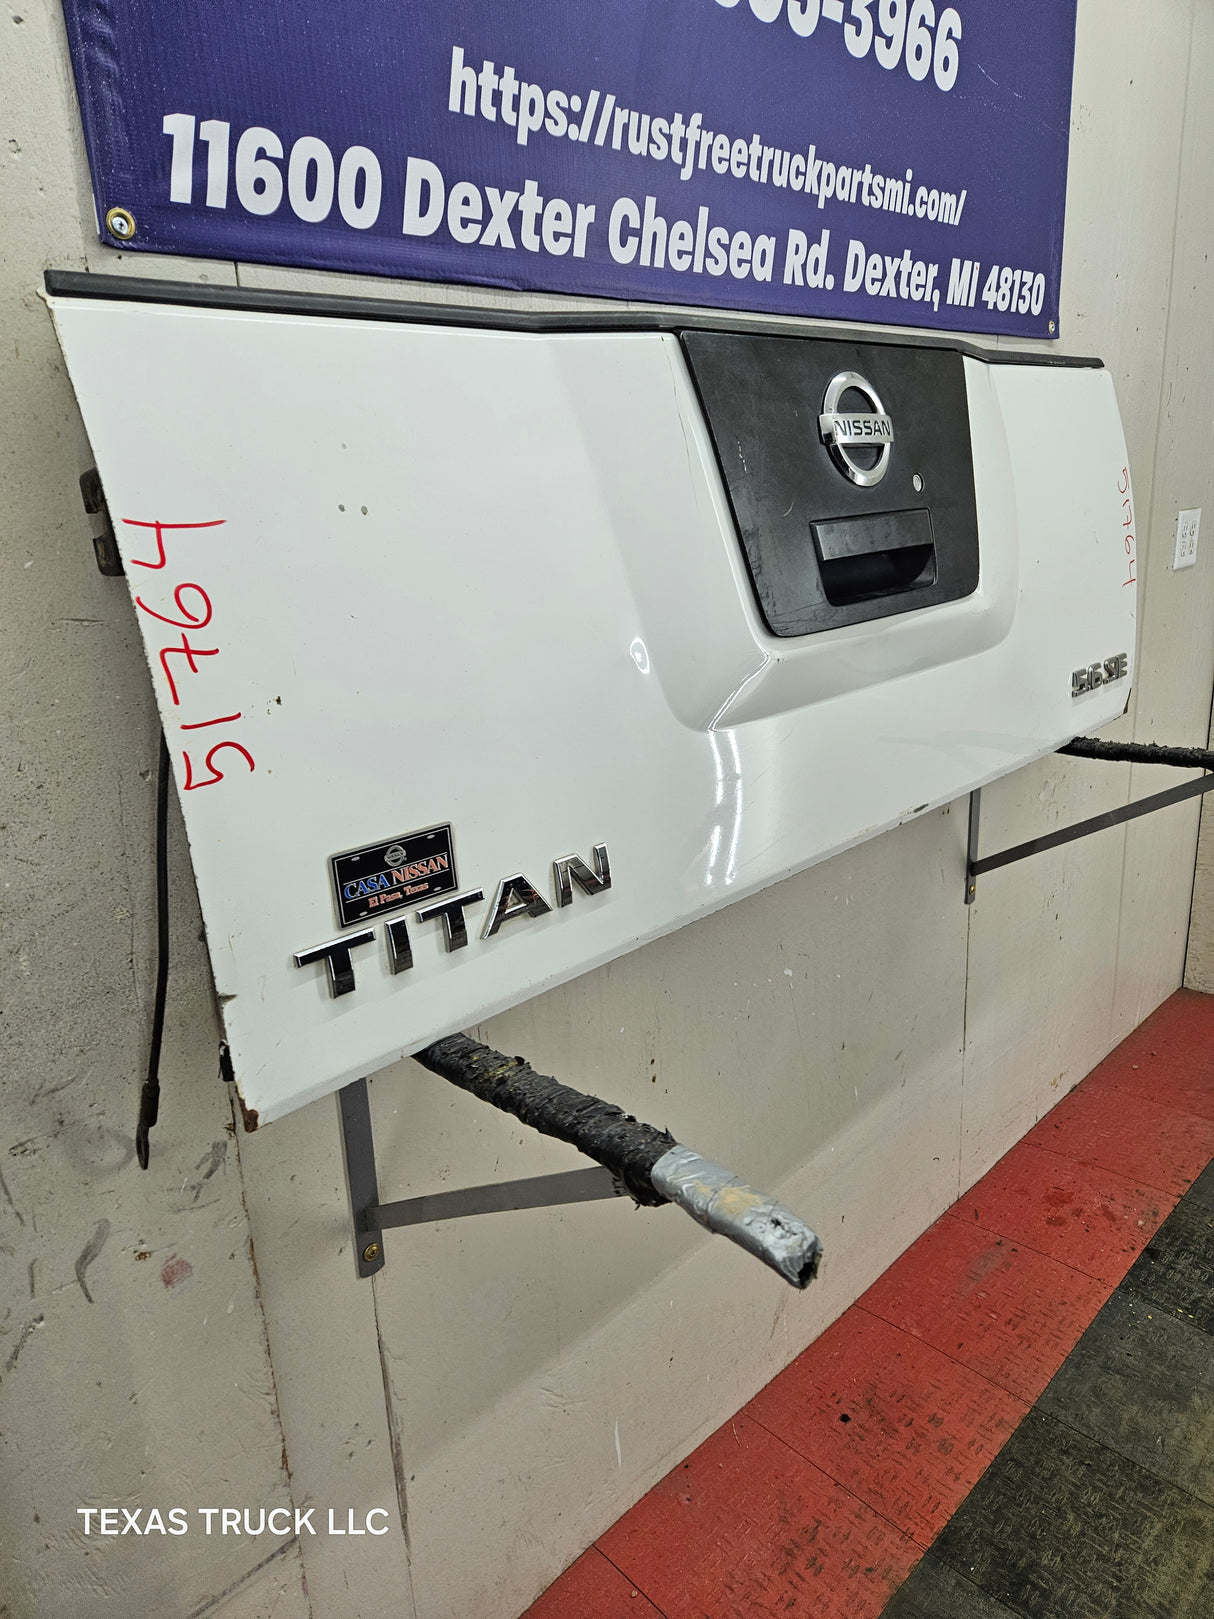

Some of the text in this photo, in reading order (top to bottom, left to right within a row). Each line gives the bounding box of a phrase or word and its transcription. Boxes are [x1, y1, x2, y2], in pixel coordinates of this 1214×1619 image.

[162, 112, 1046, 316] 11600 Dexter Chelsea Rd. Dexter, MI 48130
[449, 46, 967, 226] https://rustfreetruckpartsmi.com/
[834, 419, 891, 437] NISSAN
[121, 518, 255, 791] 51764
[293, 841, 612, 999] TITAN
[344, 854, 449, 899] CASA NISSAN
